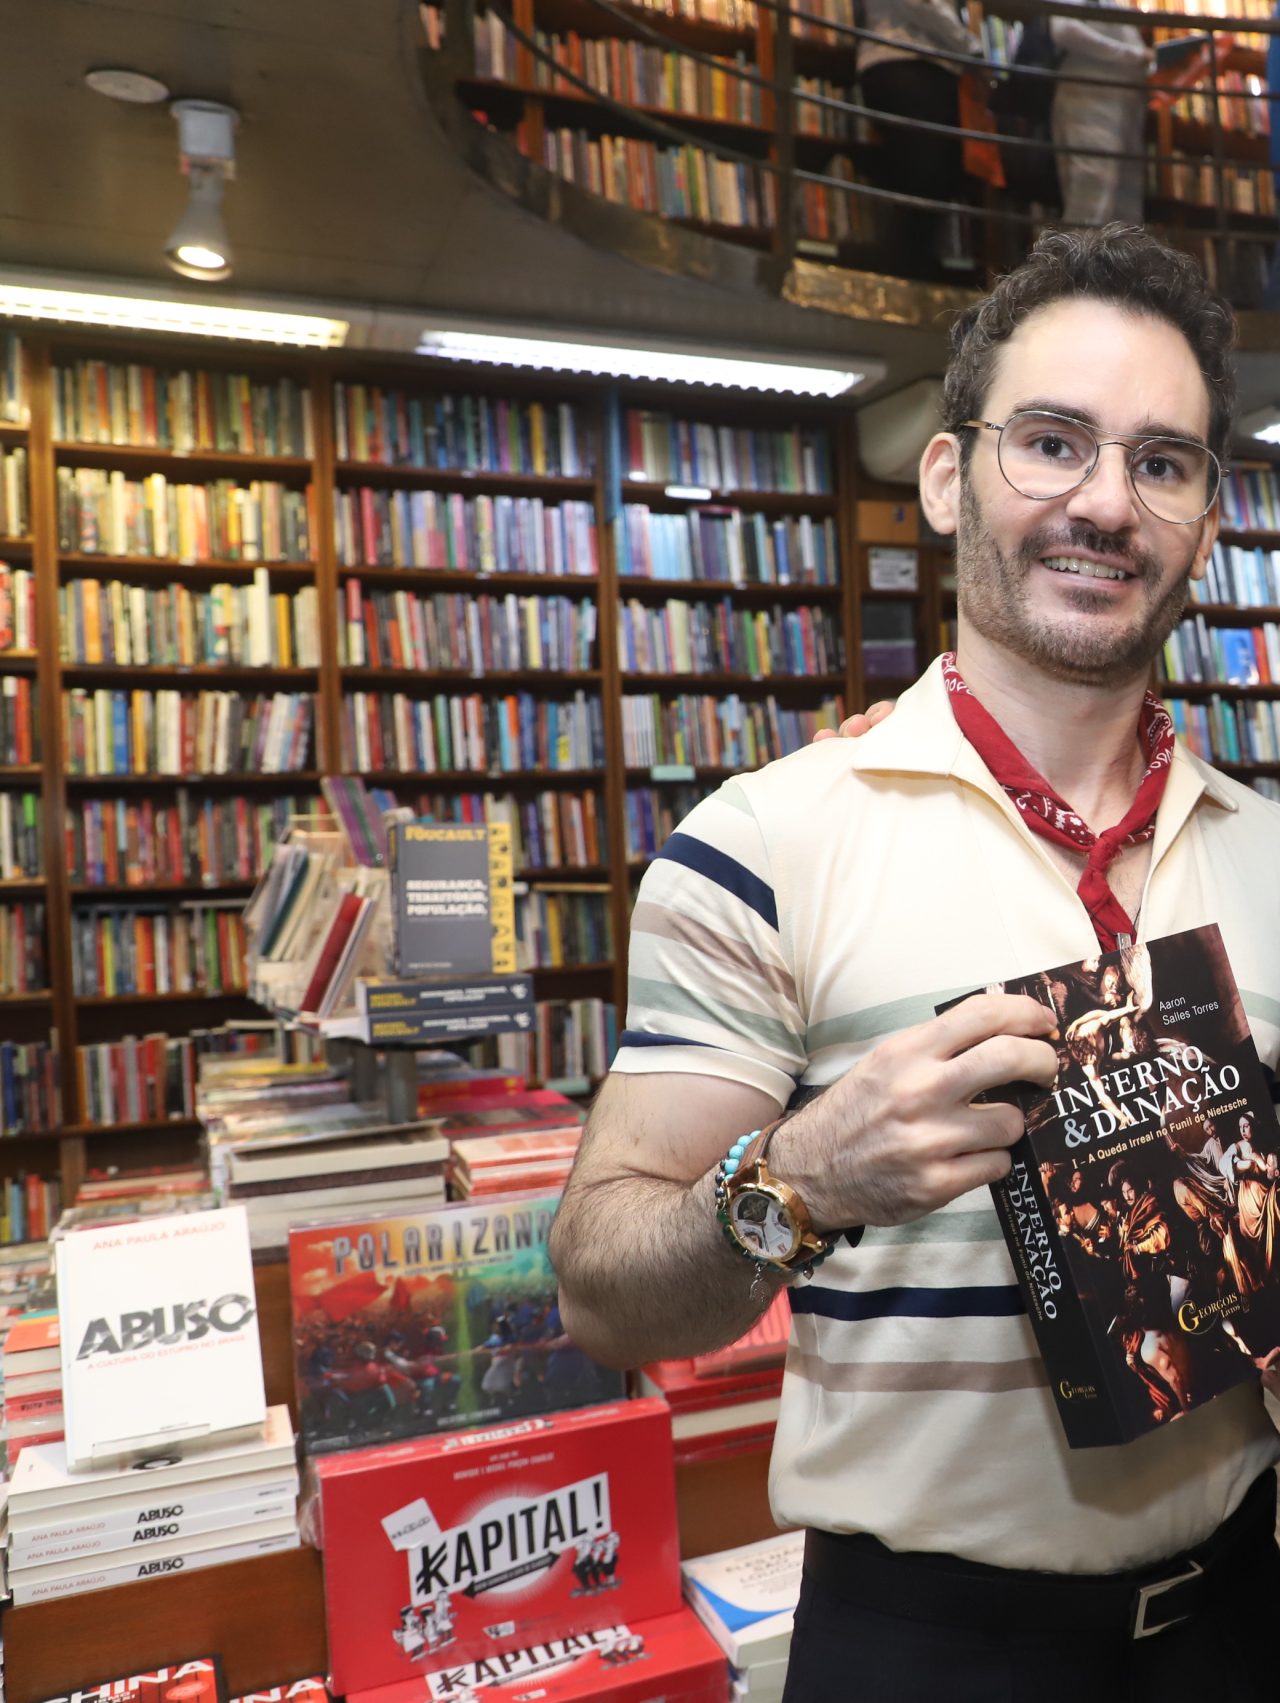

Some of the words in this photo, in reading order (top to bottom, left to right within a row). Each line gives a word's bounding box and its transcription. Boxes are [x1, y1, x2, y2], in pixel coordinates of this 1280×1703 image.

[1159, 996, 1186, 1011] Aaron
[1162, 1009, 1190, 1025] Salles
[1192, 1001, 1219, 1017] Torres
[1051, 1045, 1204, 1118] INFERNO
[1064, 1118, 1091, 1148] &
[1090, 1064, 1240, 1139] DANAÇÃO
[1072, 1158, 1079, 1169] I
[1088, 1151, 1096, 1163] A
[1097, 1141, 1128, 1161] Queda
[1129, 1132, 1154, 1148] Irreal
[1156, 1126, 1168, 1138] no
[1170, 1117, 1193, 1132] Funil
[1194, 1112, 1206, 1124] de
[1207, 1097, 1248, 1118] Nietzsche
[94, 1241, 122, 1250] ANA
[127, 1231, 168, 1245] PAULA
[1009, 1190, 1057, 1319] DANAÇÃO
[1014, 1161, 1062, 1290] INFERNO
[75, 1293, 257, 1361] ABUSO
[133, 1522, 180, 1542] ABUSO
[137, 1504, 184, 1523] ABUSO
[416, 1481, 603, 1595] KAPITAL!
[137, 1557, 185, 1577] ABUSO
